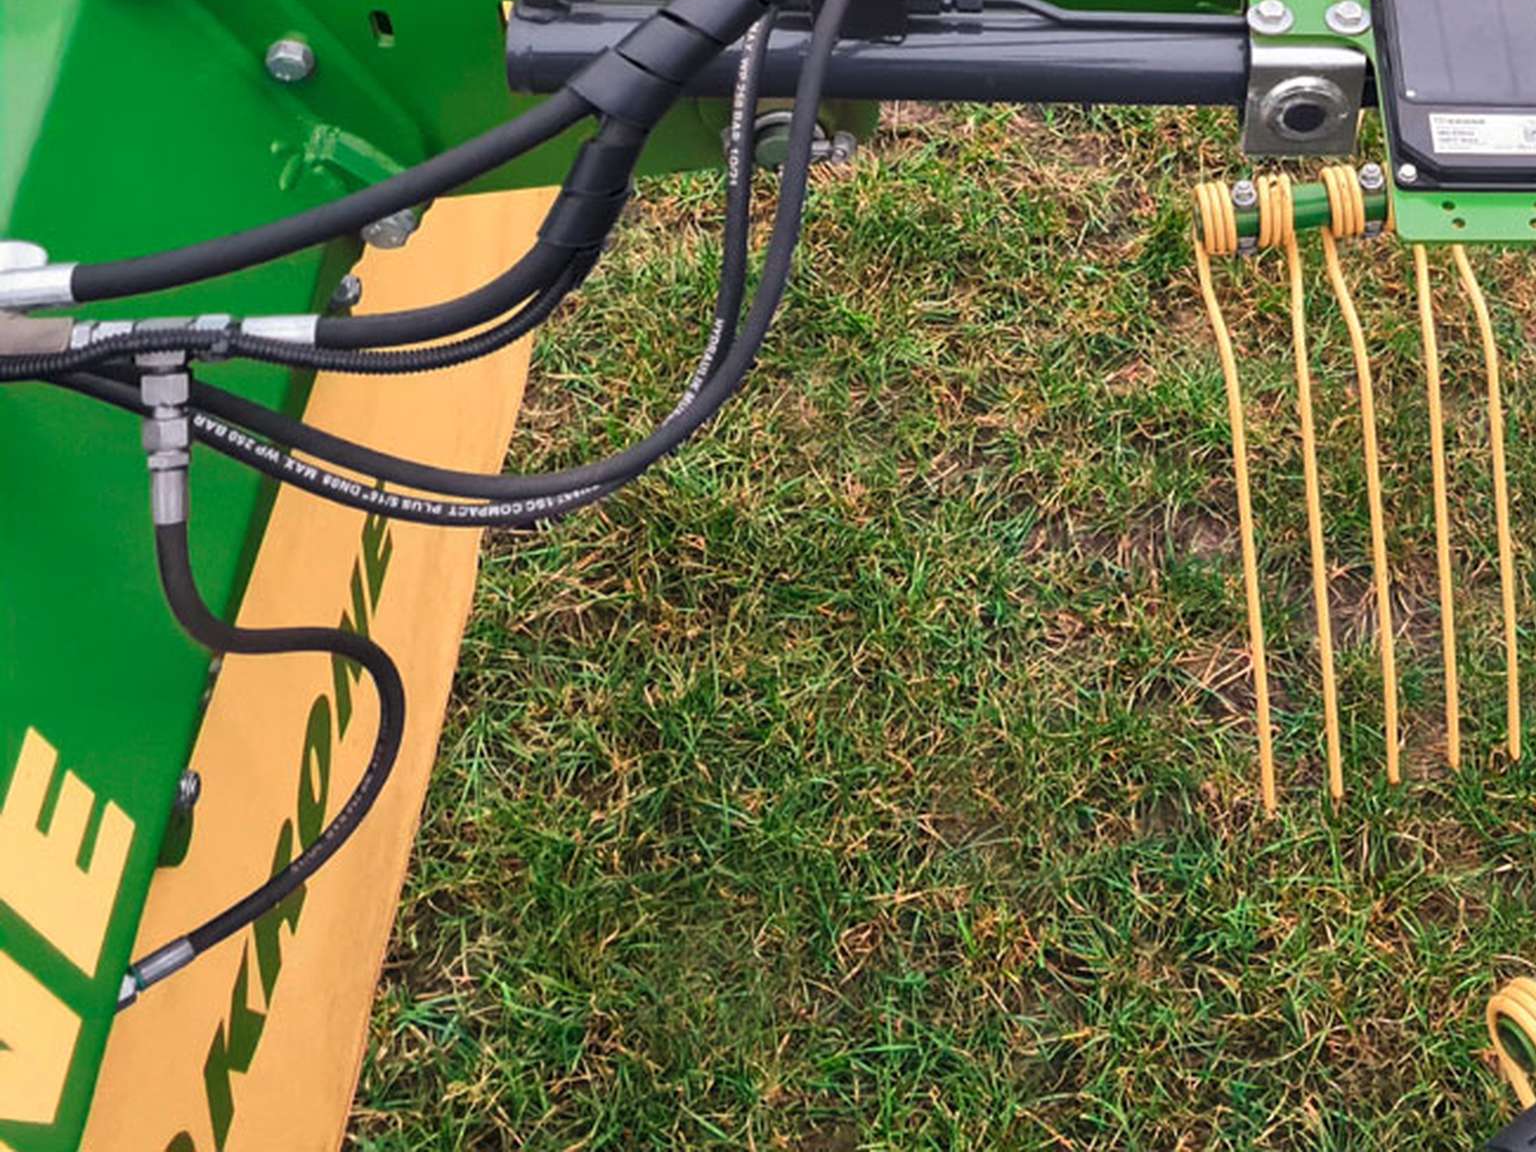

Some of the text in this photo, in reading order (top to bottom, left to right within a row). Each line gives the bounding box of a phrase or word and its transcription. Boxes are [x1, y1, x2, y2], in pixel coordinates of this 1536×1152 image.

[192, 412, 228, 438] BAR
[254, 445, 281, 464] WP
[401, 499, 443, 515] PLUS
[447, 502, 523, 518] COMPACT
